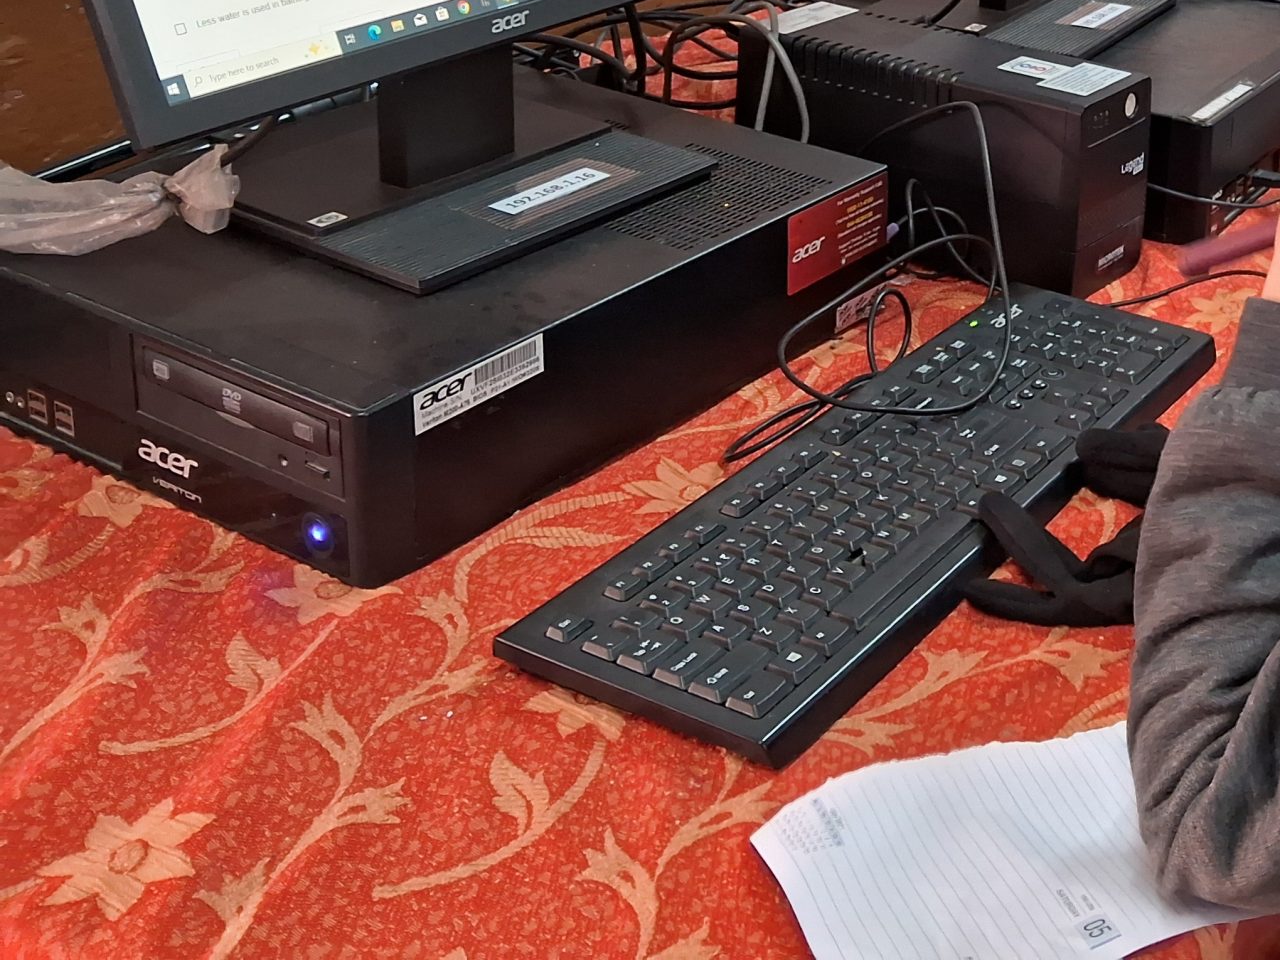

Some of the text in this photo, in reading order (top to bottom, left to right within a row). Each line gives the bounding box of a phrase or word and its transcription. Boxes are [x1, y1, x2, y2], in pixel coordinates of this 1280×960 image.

[196, 19, 217, 30] Less
[217, 10, 240, 24] water
[242, 8, 250, 16] is
[251, 2, 271, 15] used
[272, 1, 280, 10] in
[492, 10, 530, 33] acer
[208, 57, 280, 83] Type here to search
[792, 236, 827, 263] acer
[222, 388, 242, 400] DVD
[420, 372, 473, 411] acer
[138, 438, 199, 480] acer
[152, 476, 203, 504] VERITON
[1083, 918, 1112, 938] 05
